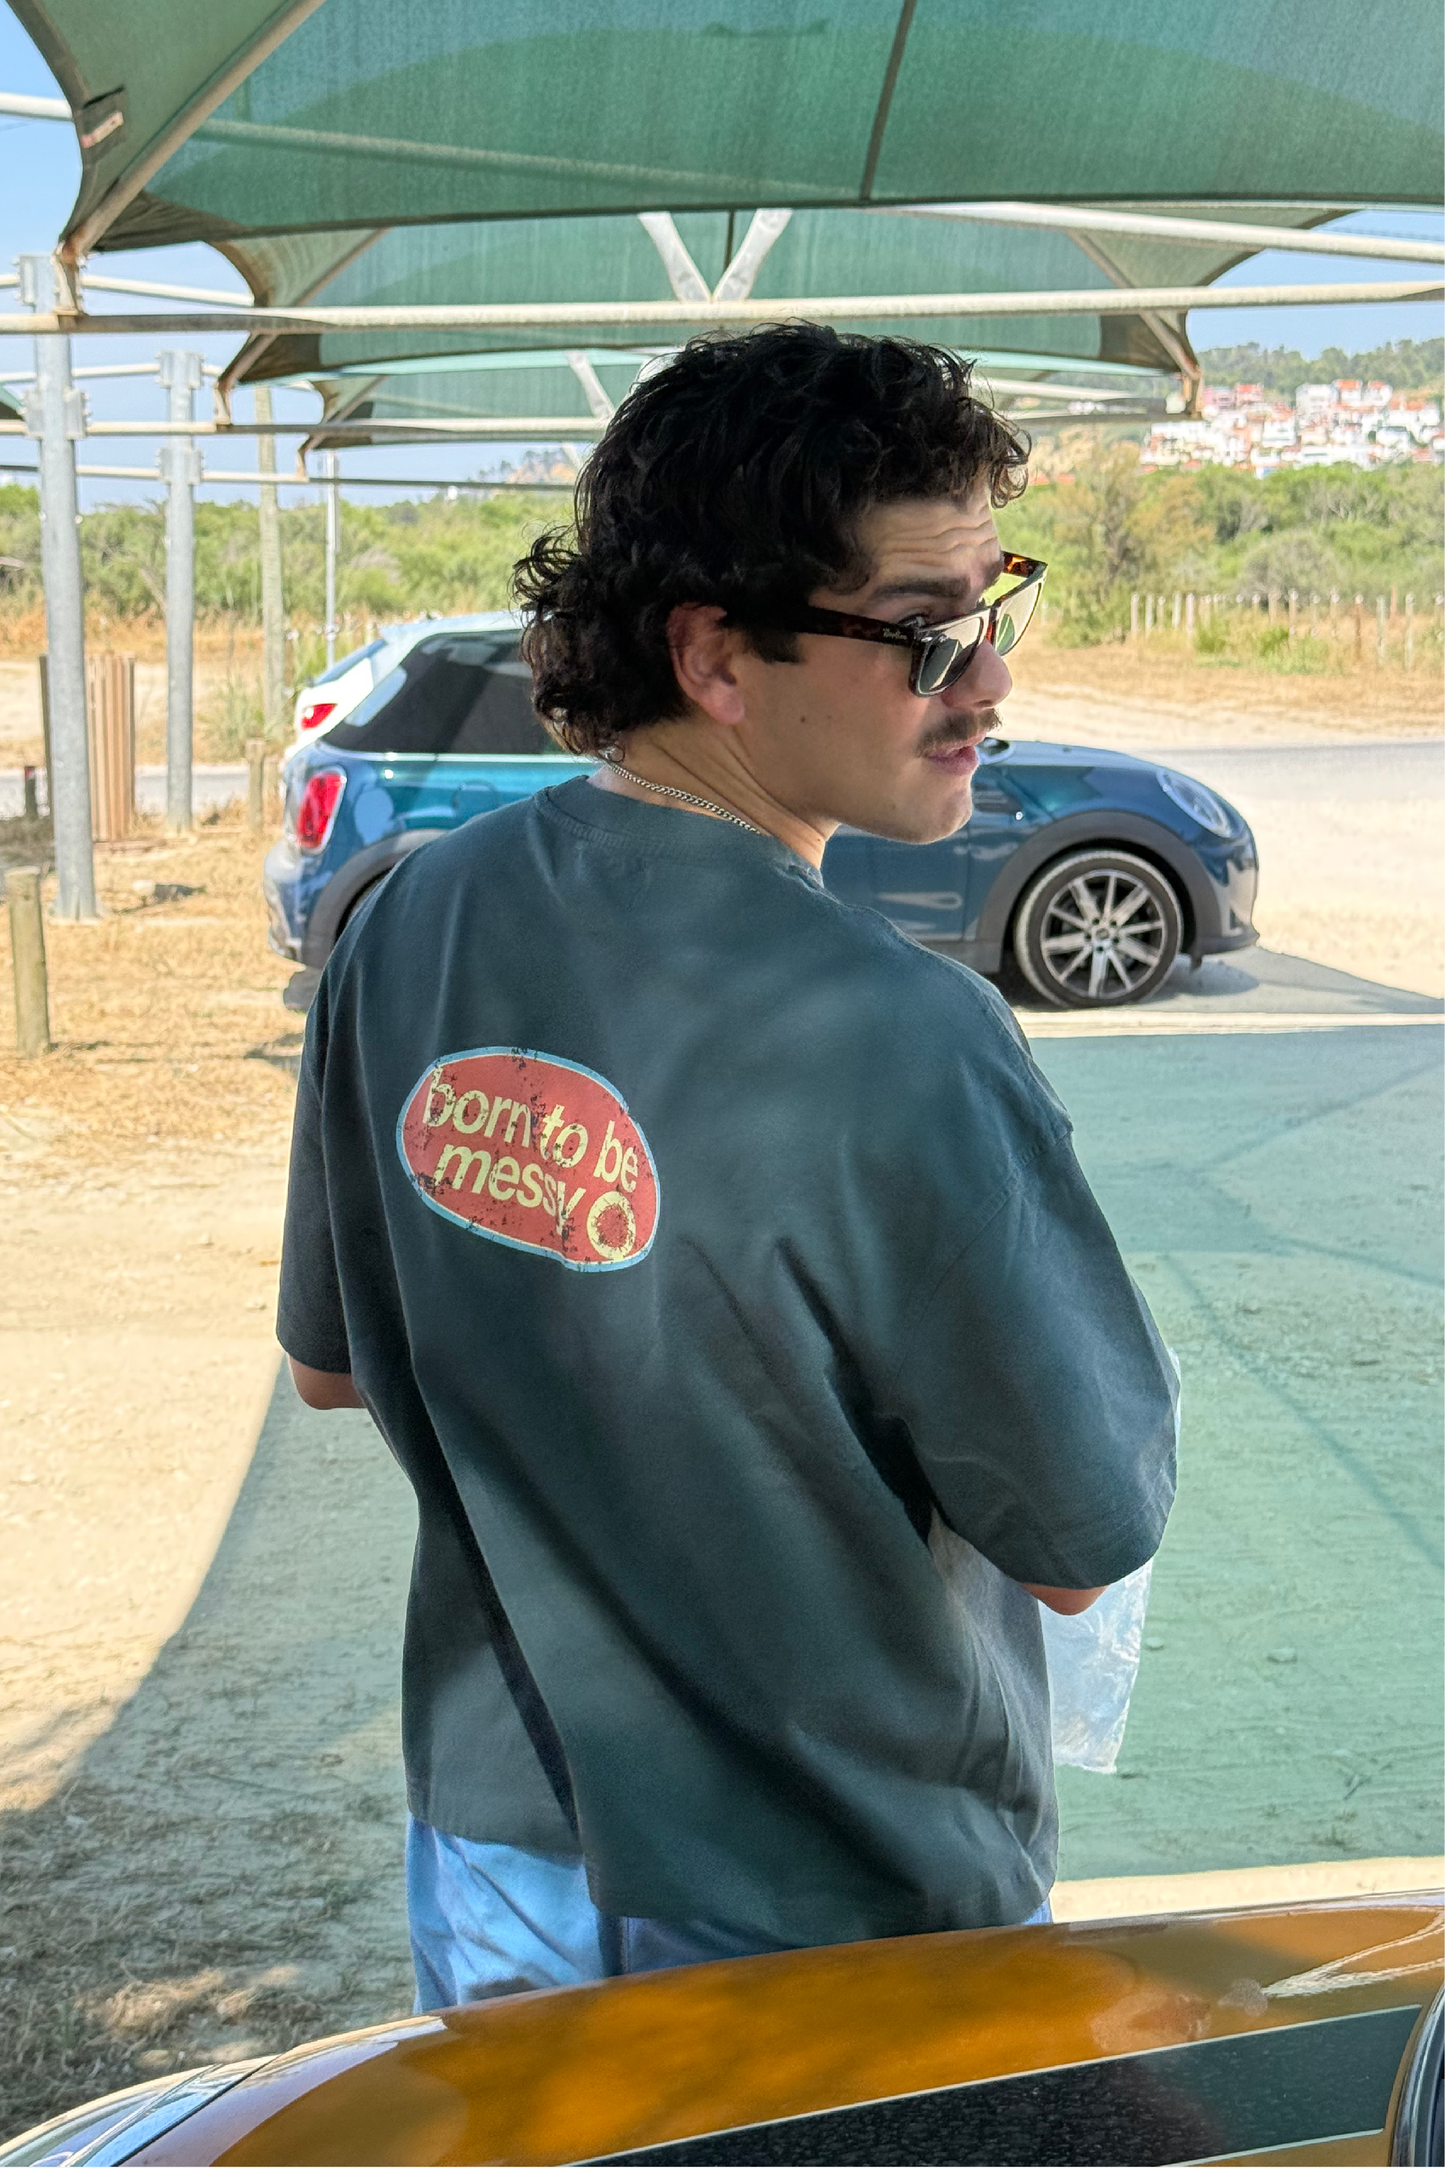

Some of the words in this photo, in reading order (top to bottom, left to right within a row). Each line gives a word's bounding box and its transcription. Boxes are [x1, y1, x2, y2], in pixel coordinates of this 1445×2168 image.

[423, 1068, 531, 1148] born
[540, 1104, 588, 1168] to
[593, 1119, 638, 1193] be
[434, 1143, 585, 1236] messy
